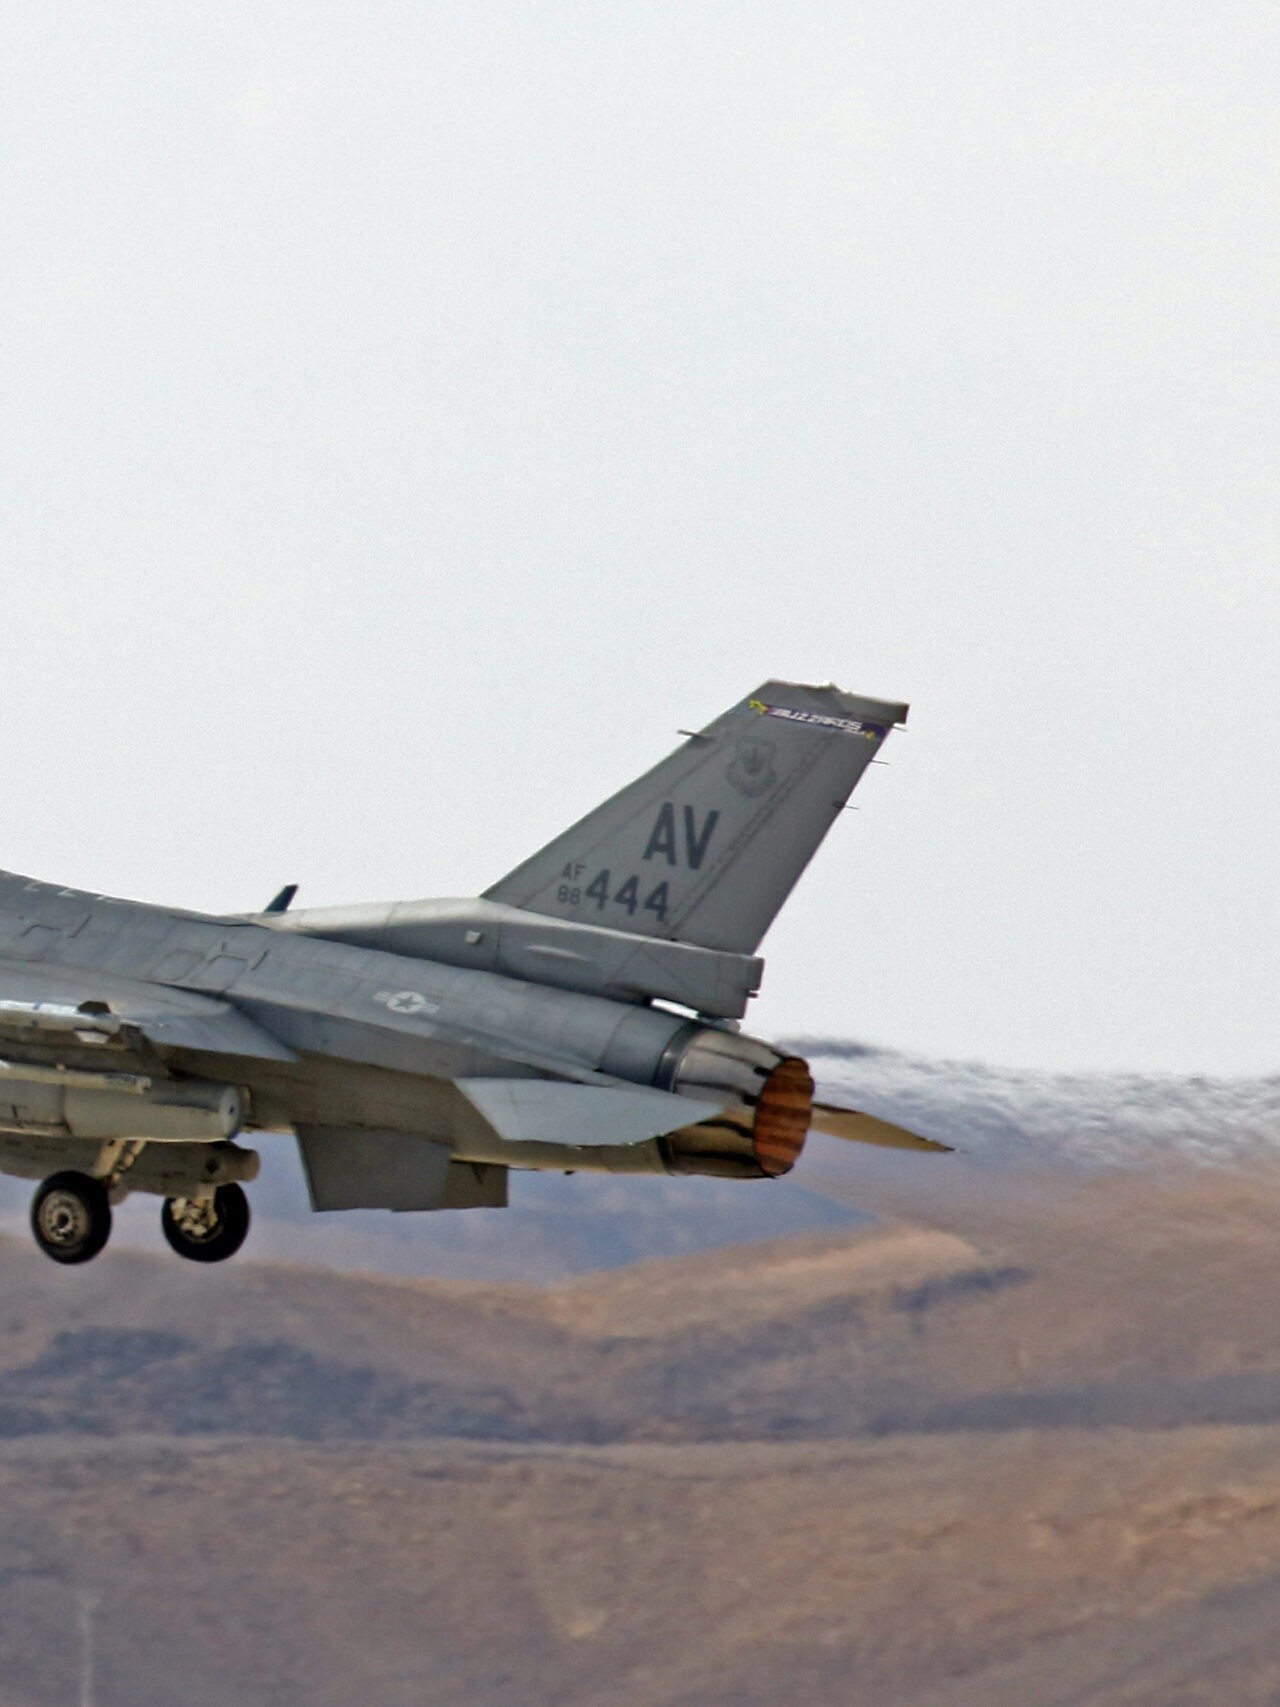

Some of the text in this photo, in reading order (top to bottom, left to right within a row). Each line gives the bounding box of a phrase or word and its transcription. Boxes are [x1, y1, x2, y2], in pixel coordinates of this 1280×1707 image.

[642, 801, 720, 871] AV
[561, 861, 586, 881] AF
[586, 868, 669, 923] 444
